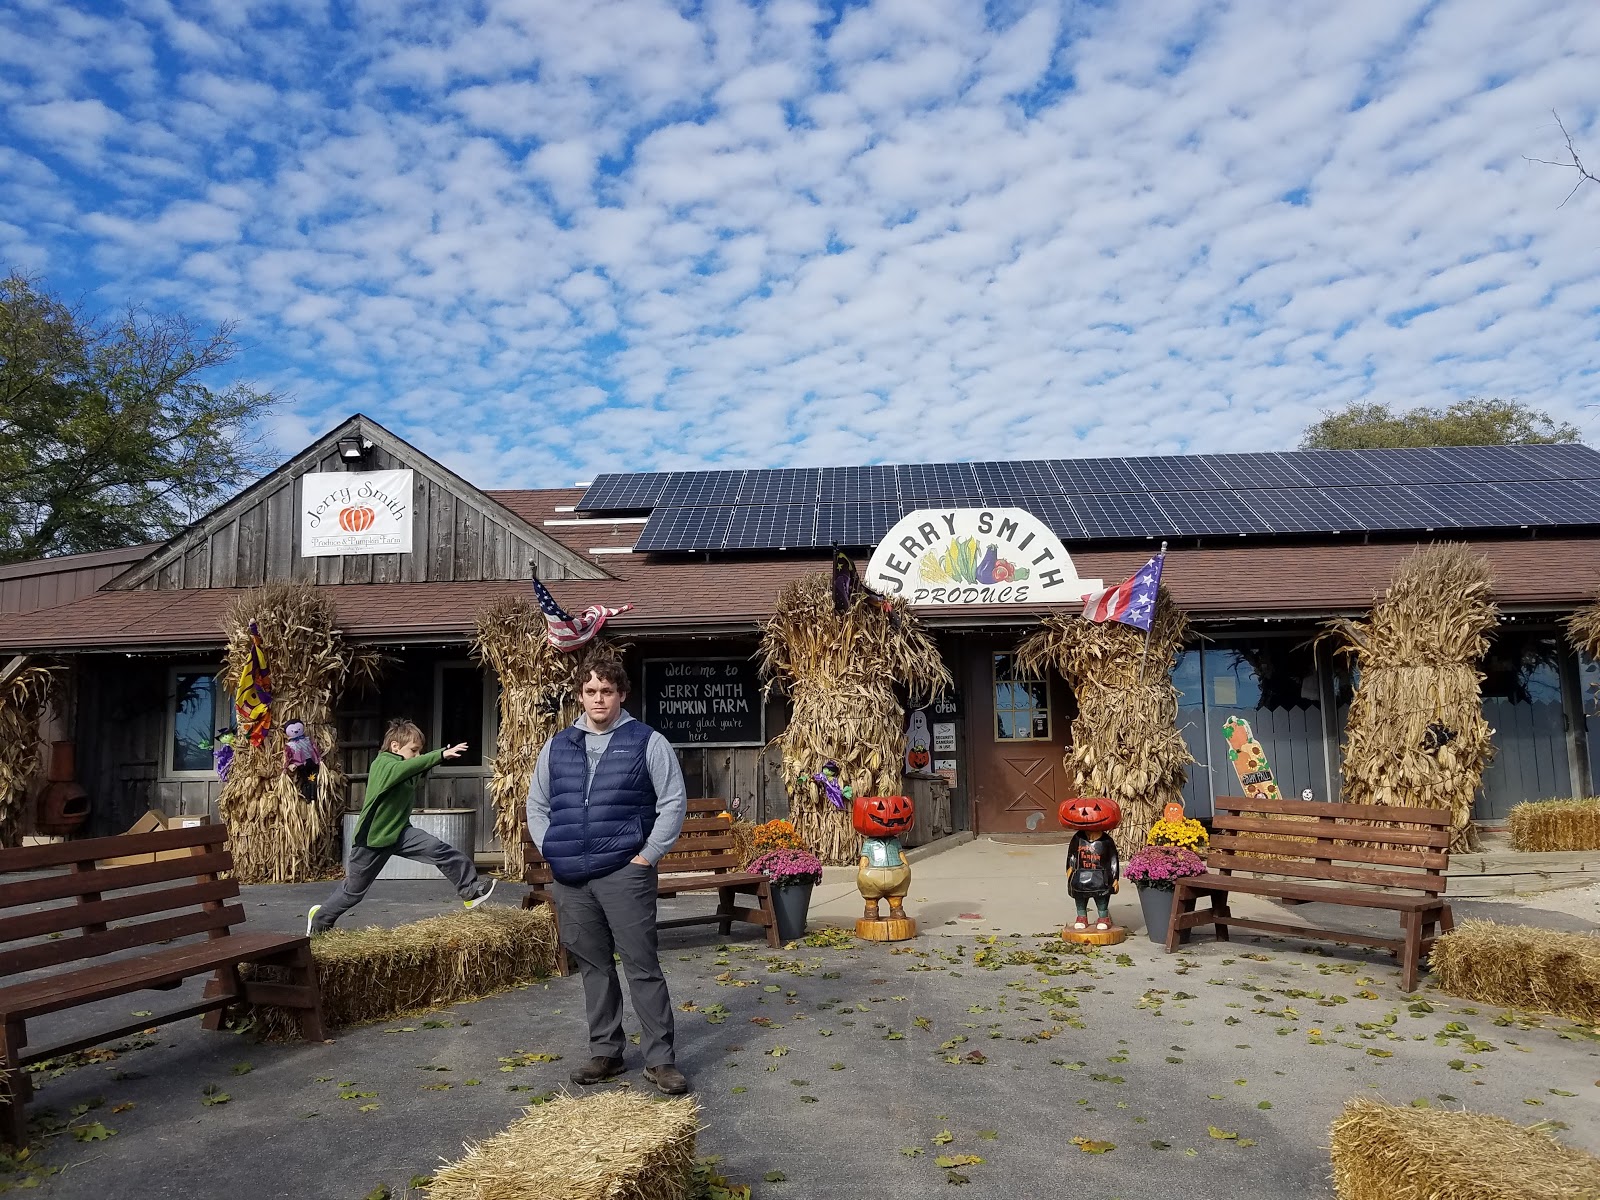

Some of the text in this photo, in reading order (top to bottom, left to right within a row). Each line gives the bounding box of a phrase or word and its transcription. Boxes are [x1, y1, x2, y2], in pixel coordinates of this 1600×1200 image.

[307, 480, 406, 529] Jerry Smith
[311, 538, 341, 547] Produce
[347, 536, 379, 547] Pumpkin
[380, 534, 401, 544] Farm
[878, 511, 1065, 594] JERRY SMITH
[913, 585, 1030, 604] PRODUCE
[665, 662, 739, 678] Welcme to
[660, 683, 743, 698] JERRY SMITH
[659, 699, 749, 715] PUMPKIN FARM
[935, 703, 957, 714] OPEN
[660, 717, 743, 732] We are glad you're
[688, 730, 709, 742] here
